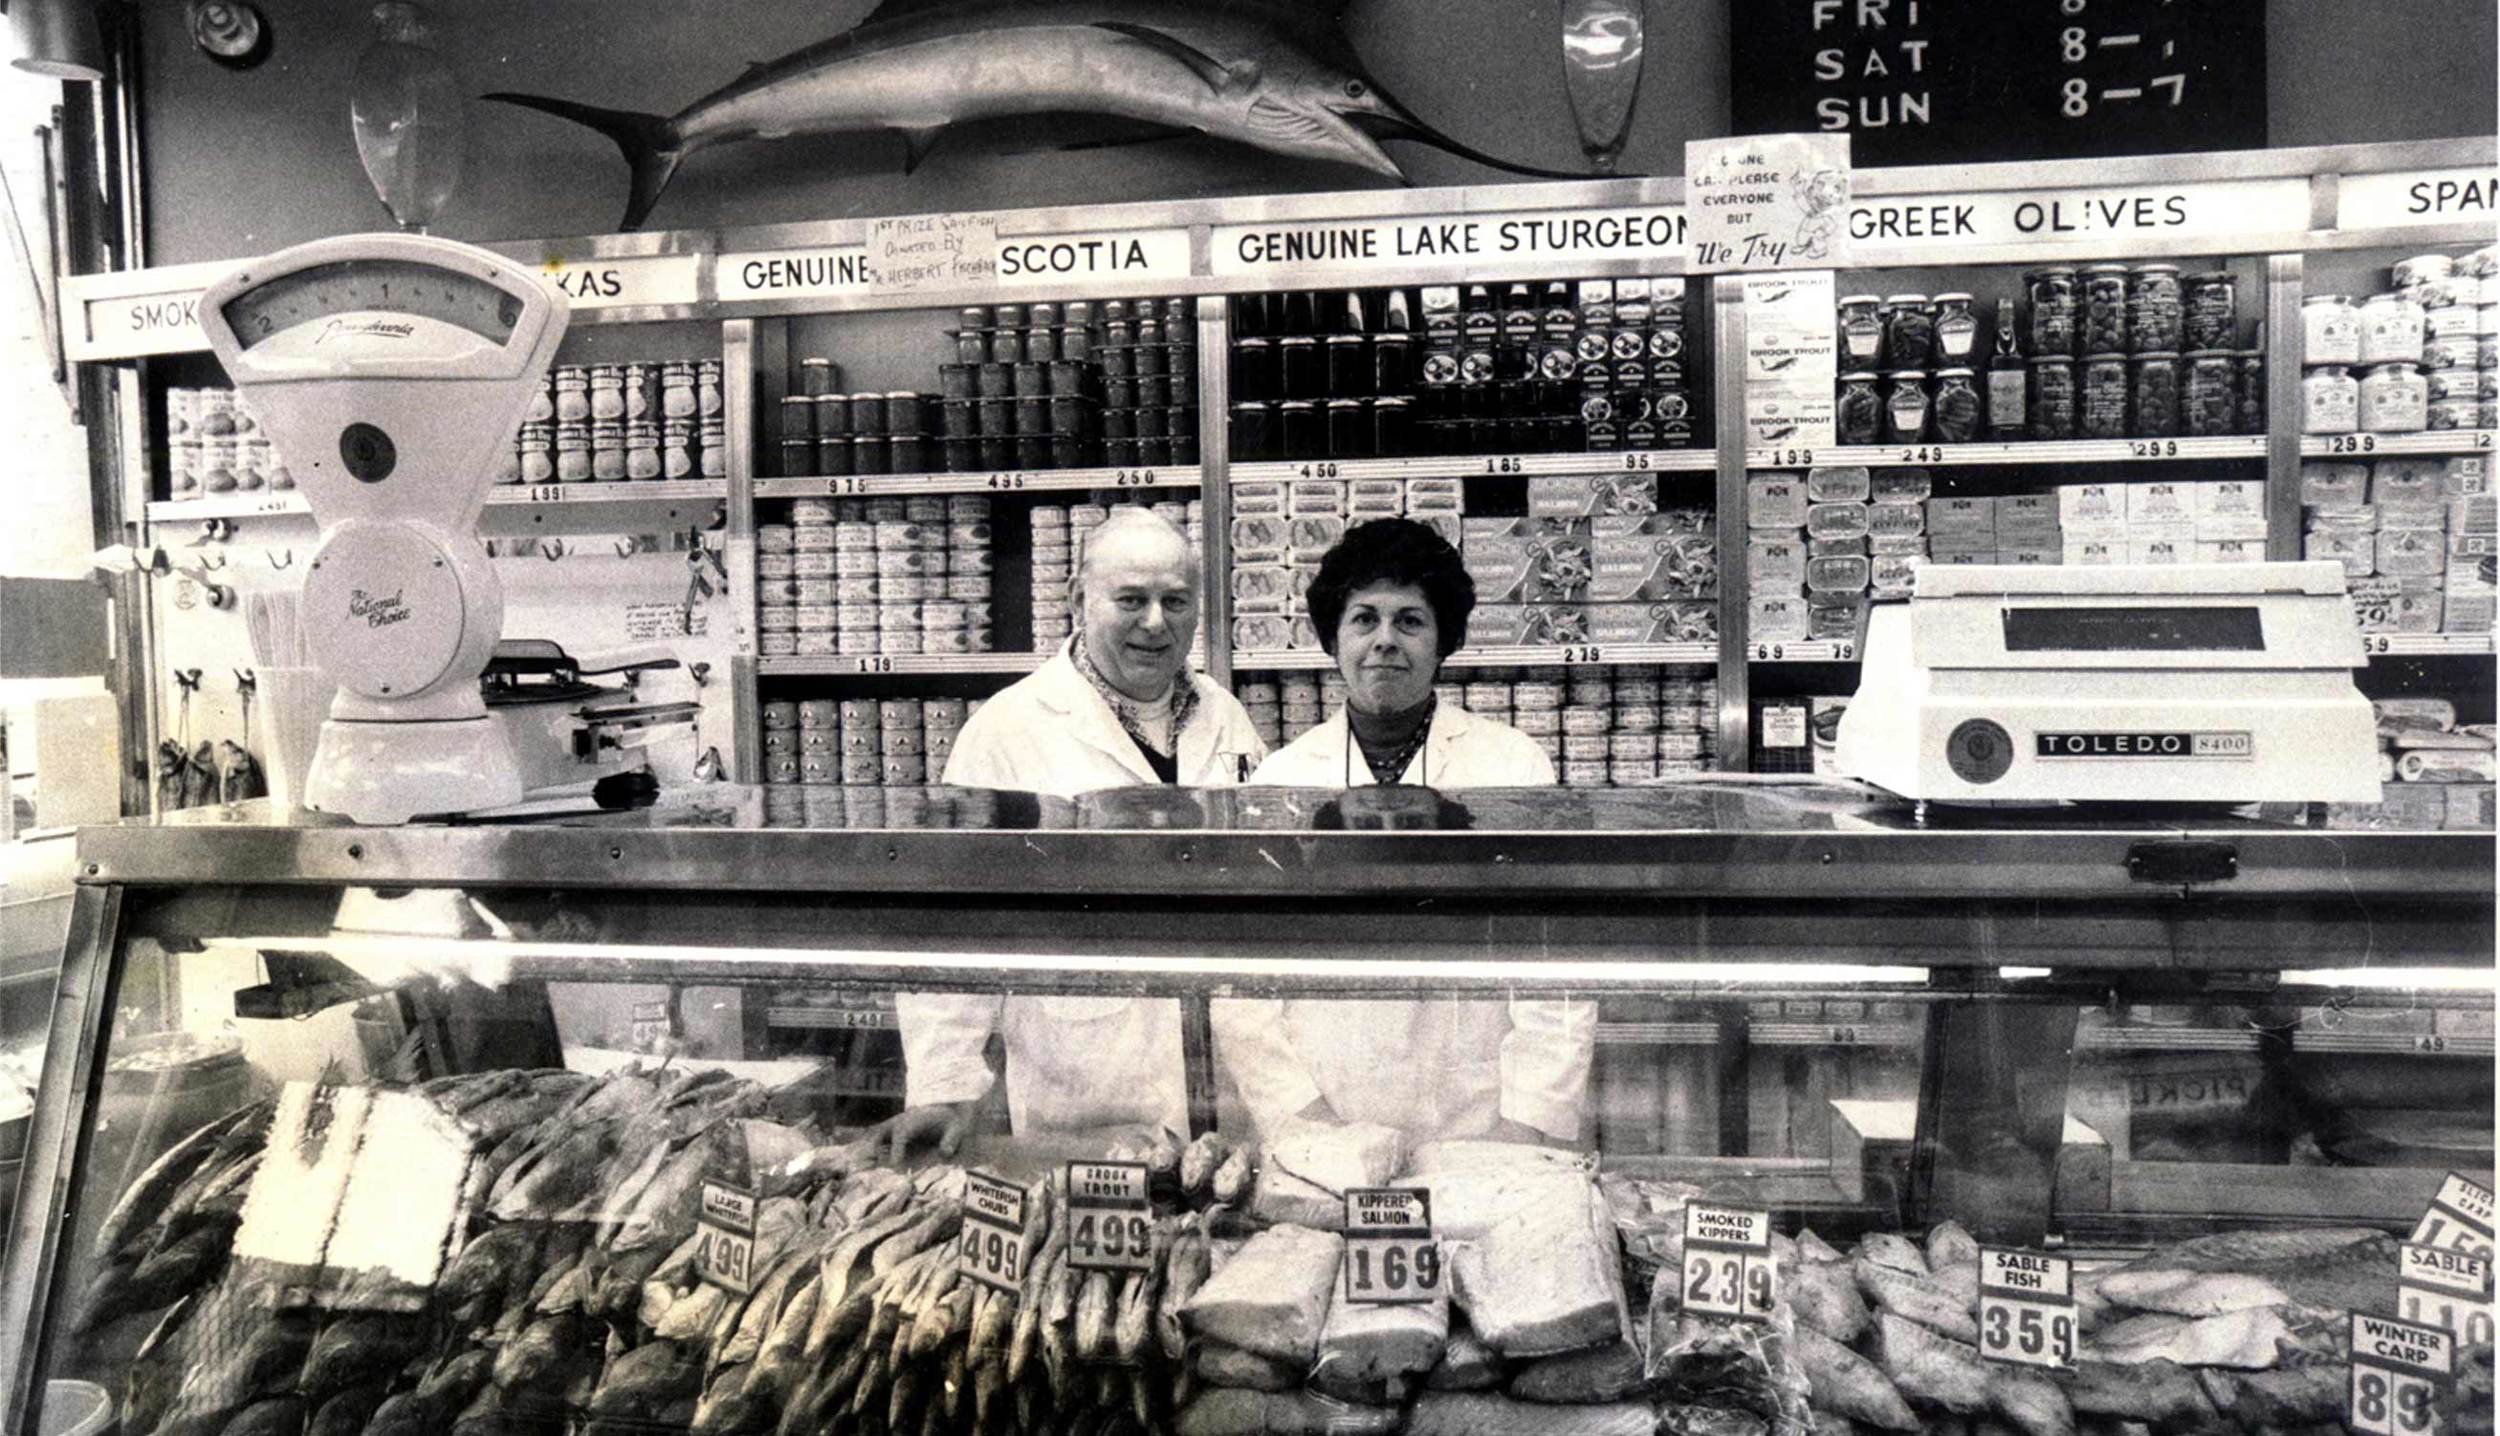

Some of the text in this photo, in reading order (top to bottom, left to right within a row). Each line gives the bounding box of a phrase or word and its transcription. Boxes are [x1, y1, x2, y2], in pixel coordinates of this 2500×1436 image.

[1813, 40, 1928, 80] SAT
[1815, 92, 1930, 130] SUN
[1703, 193, 1774, 206] EVERYONE
[1727, 213, 1752, 224] BUT
[1849, 205, 1976, 239] GREEK
[1238, 228, 1377, 263] GENUINE
[1397, 224, 1480, 256] LAKE
[1696, 233, 1786, 265] We Try
[1001, 239, 1147, 276] SCOTIA
[743, 255, 869, 290] GENUINE
[2135, 441, 2177, 456] 299
[2333, 437, 2375, 451] 299
[1626, 454, 1649, 469] 95
[1772, 448, 1943, 465] 199 249
[1300, 464, 1337, 478] 450
[1486, 458, 1521, 473] 185
[829, 478, 866, 493] 975
[1117, 470, 1155, 486] 250
[1758, 645, 1783, 660] 69
[1833, 645, 1853, 659] 79
[2364, 637, 2389, 652] 59
[1565, 648, 1600, 662] 279
[859, 657, 891, 672] 179
[2044, 735, 2246, 754] TOLEDO 8400
[1084, 1182, 1130, 1197] TROUT
[1361, 1211, 1411, 1225] SALMON
[1697, 1212, 1753, 1228] SMOKED
[1074, 1214, 1149, 1258] 499
[1698, 1227, 1750, 1241] KIPPERS
[963, 1227, 1017, 1282] 499
[1996, 1253, 2050, 1273] SABLE
[2410, 1248, 2479, 1277] SABLE
[1355, 1245, 1440, 1290] 169
[2005, 1271, 2042, 1288] FISH
[1985, 1306, 2075, 1366] 359
[2364, 1319, 2440, 1350] WINTER
[2375, 1340, 2429, 1364] CARP
[2359, 1373, 2431, 1432] 89
